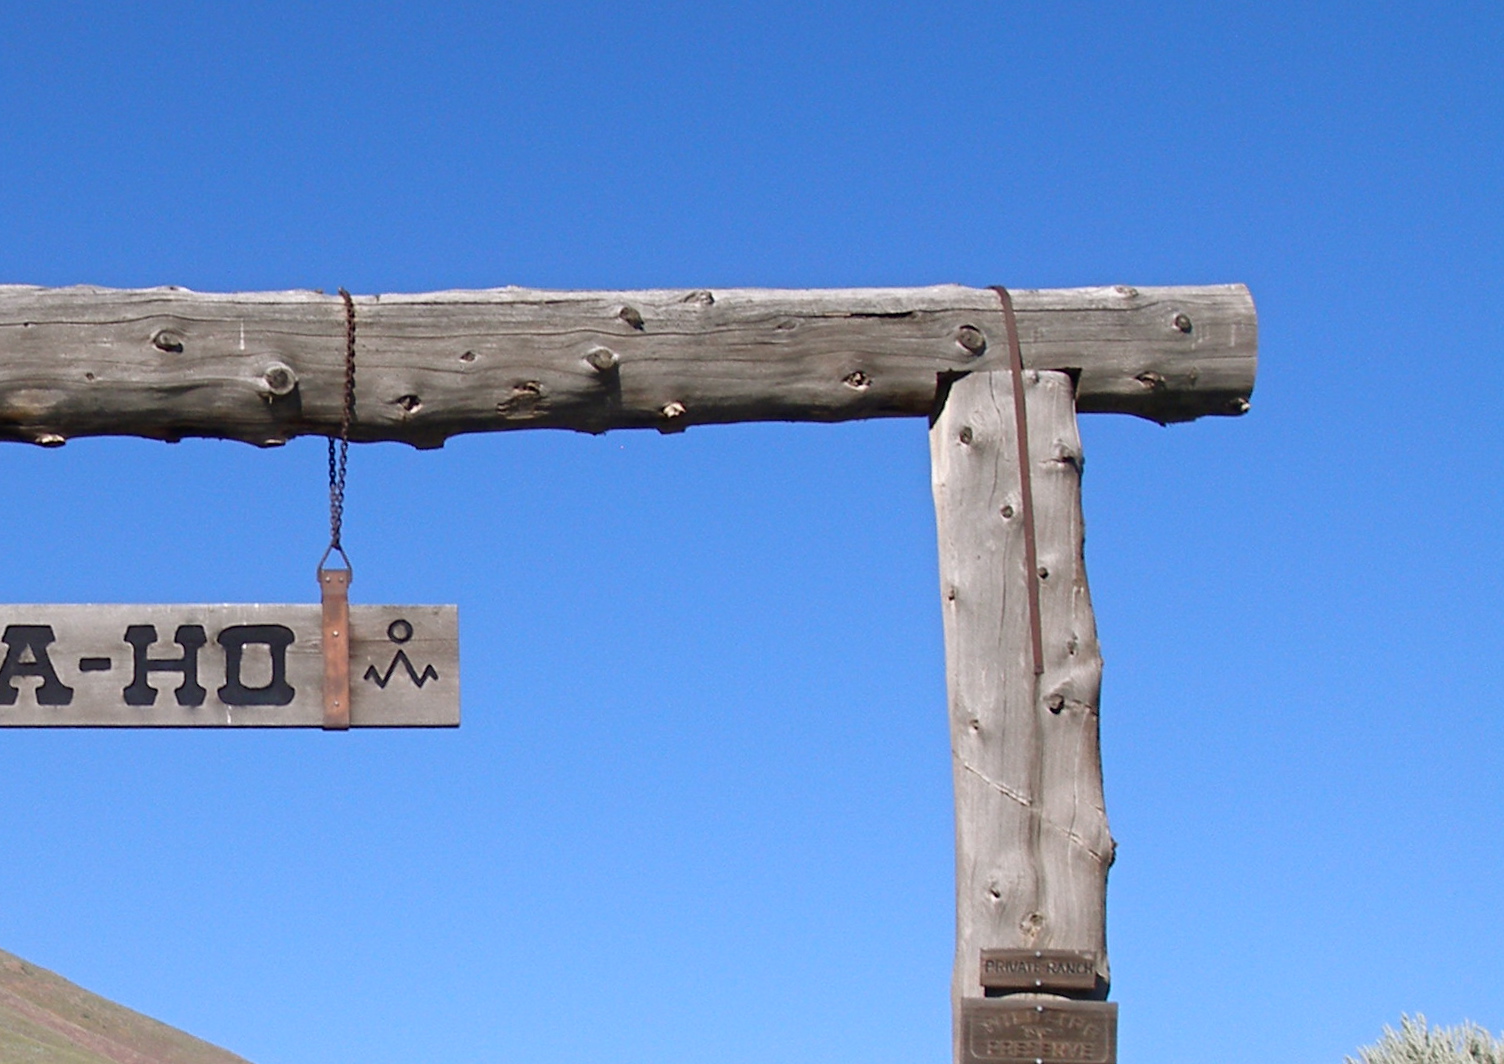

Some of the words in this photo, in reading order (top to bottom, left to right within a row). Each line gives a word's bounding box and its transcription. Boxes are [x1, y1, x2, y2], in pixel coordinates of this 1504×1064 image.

[985, 960, 1040, 973] PRIVATE
[1047, 960, 1094, 974] RANCH
[986, 1040, 1095, 1060] PRESERVE
